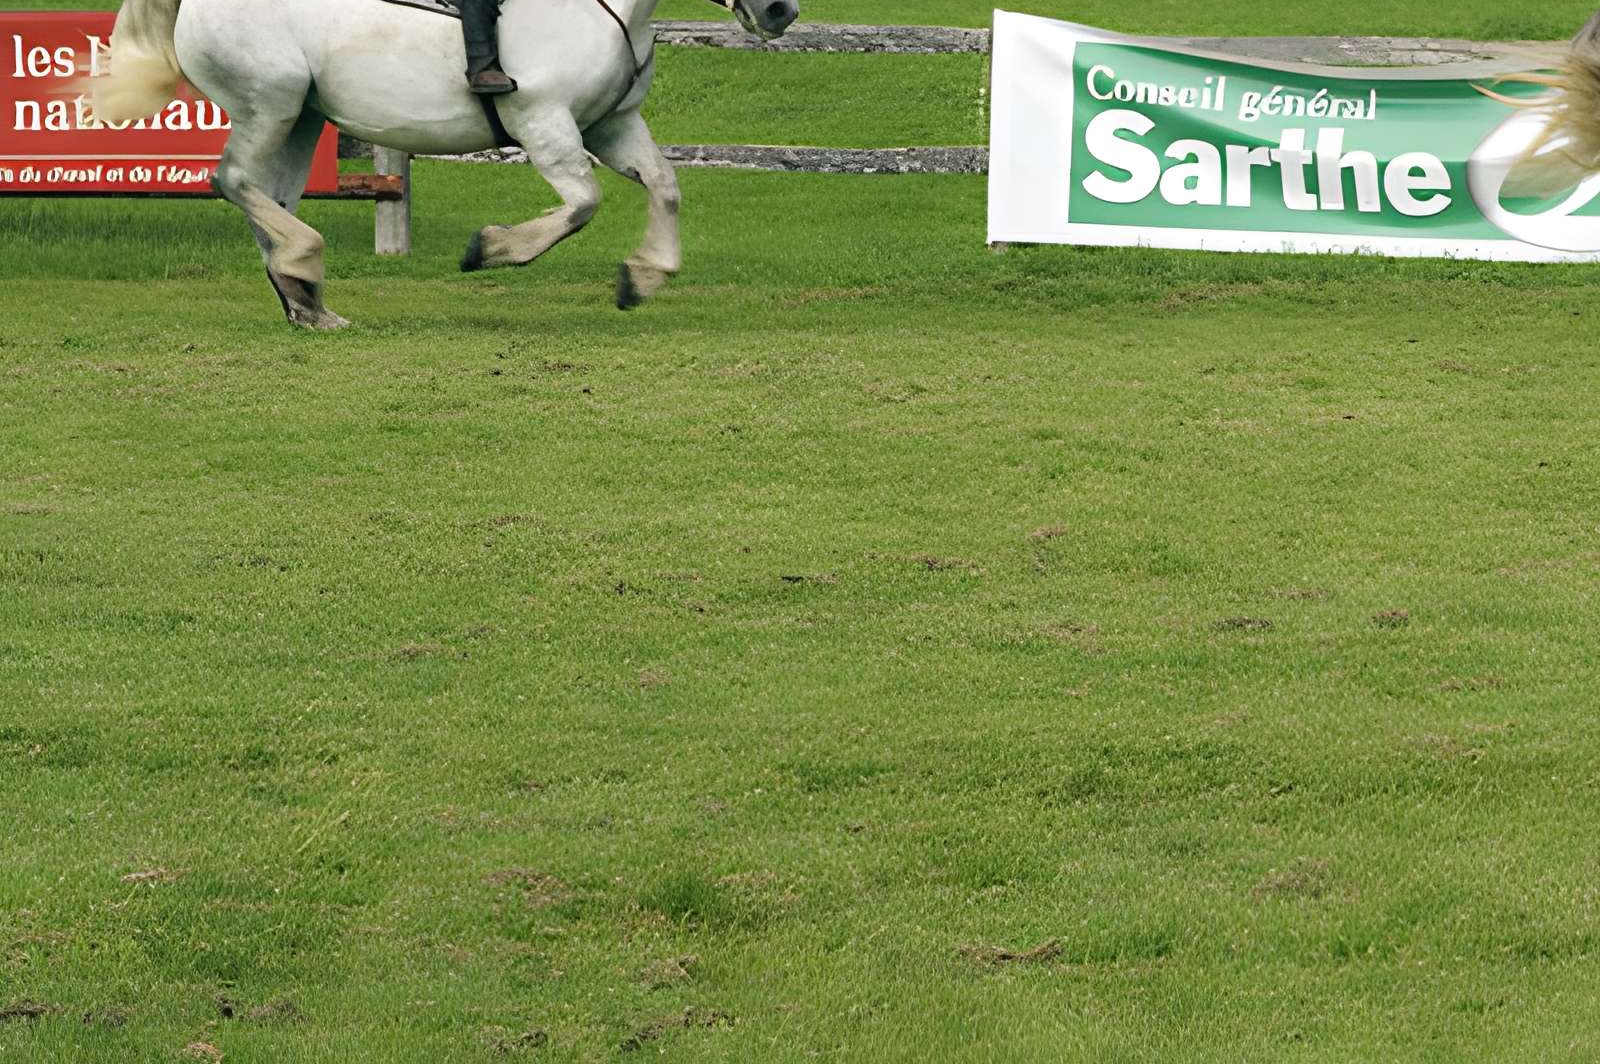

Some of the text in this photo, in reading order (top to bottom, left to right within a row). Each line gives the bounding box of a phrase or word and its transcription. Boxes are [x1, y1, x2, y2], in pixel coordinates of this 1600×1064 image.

[12, 34, 75, 78] les
[1086, 63, 1377, 121] Conseil général
[1081, 108, 1453, 217] Sarthe
